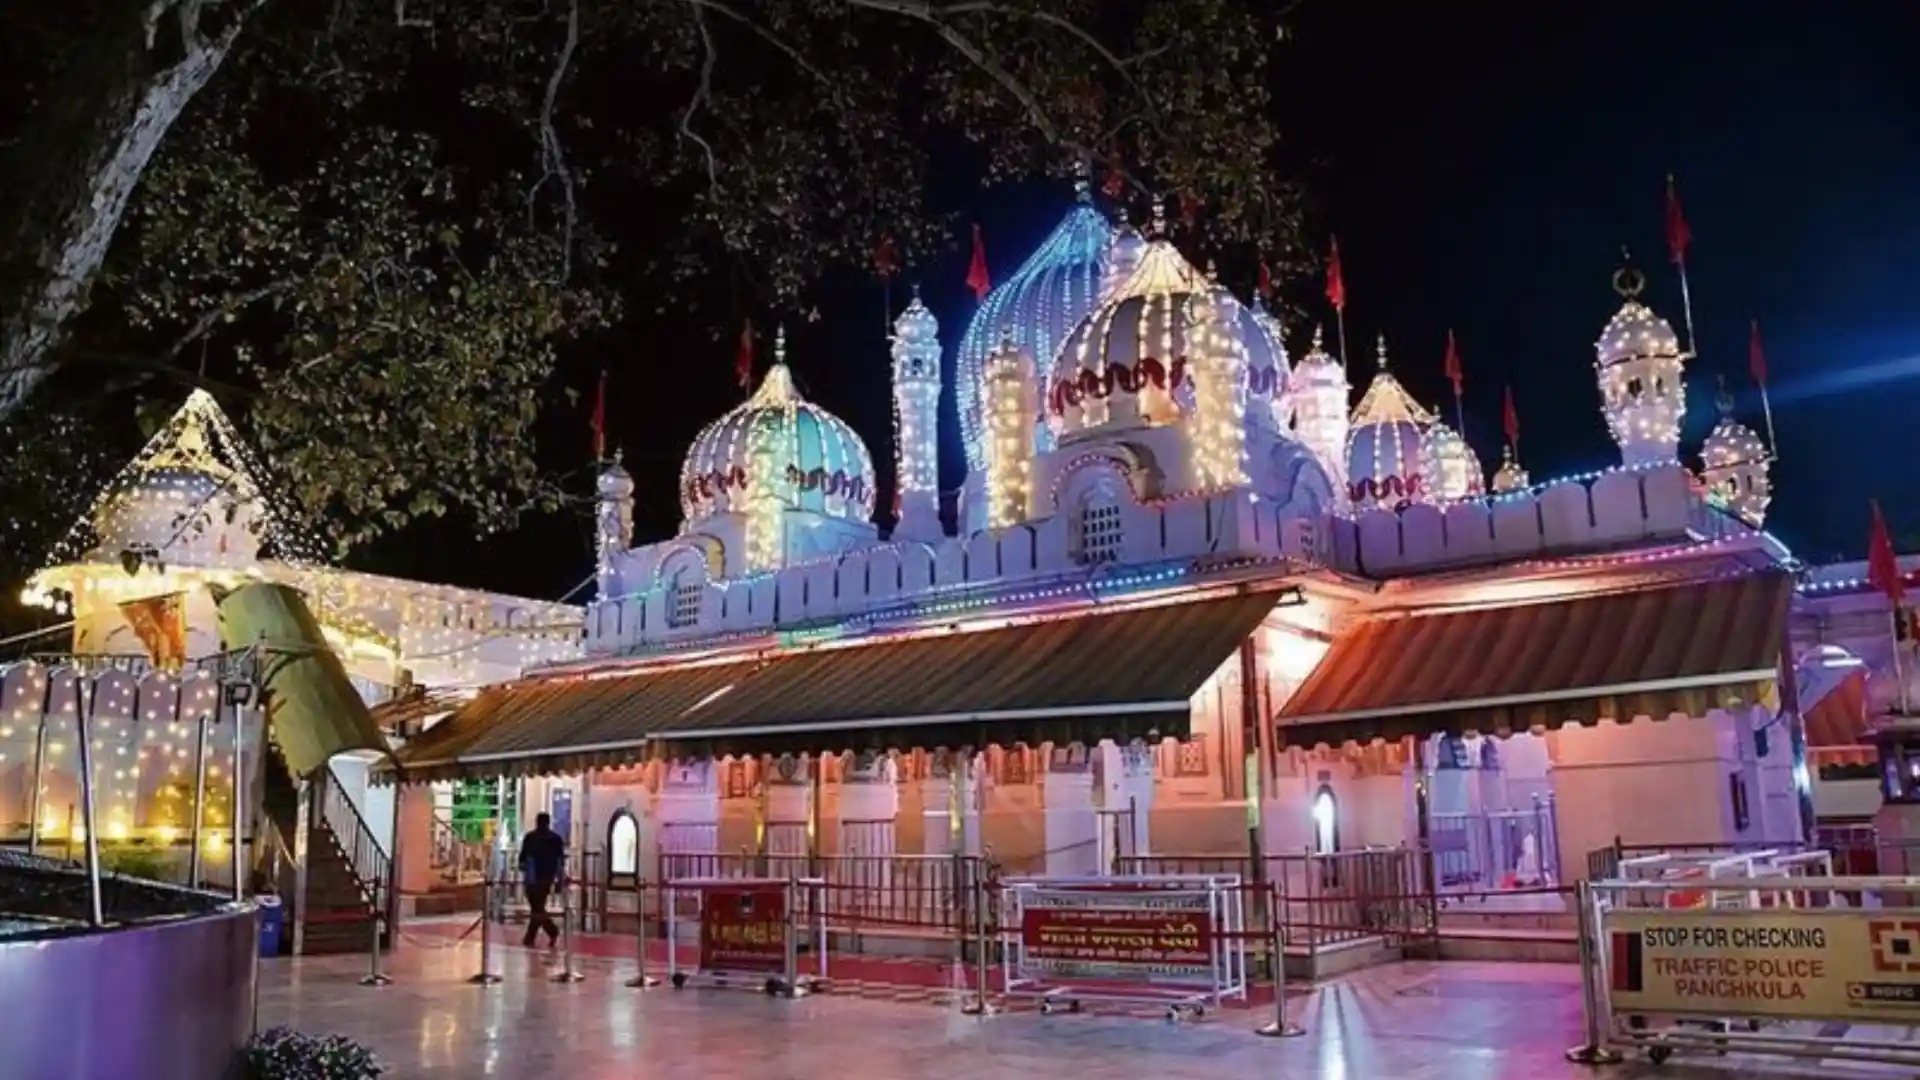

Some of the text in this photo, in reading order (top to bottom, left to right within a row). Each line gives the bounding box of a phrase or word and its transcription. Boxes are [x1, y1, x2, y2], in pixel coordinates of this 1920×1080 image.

[1644, 927, 1826, 949] STOP FOR CHECKING
[1651, 957, 1826, 978] TRAFFIC POLICE
[1674, 979, 1806, 999] PANCHKULA
